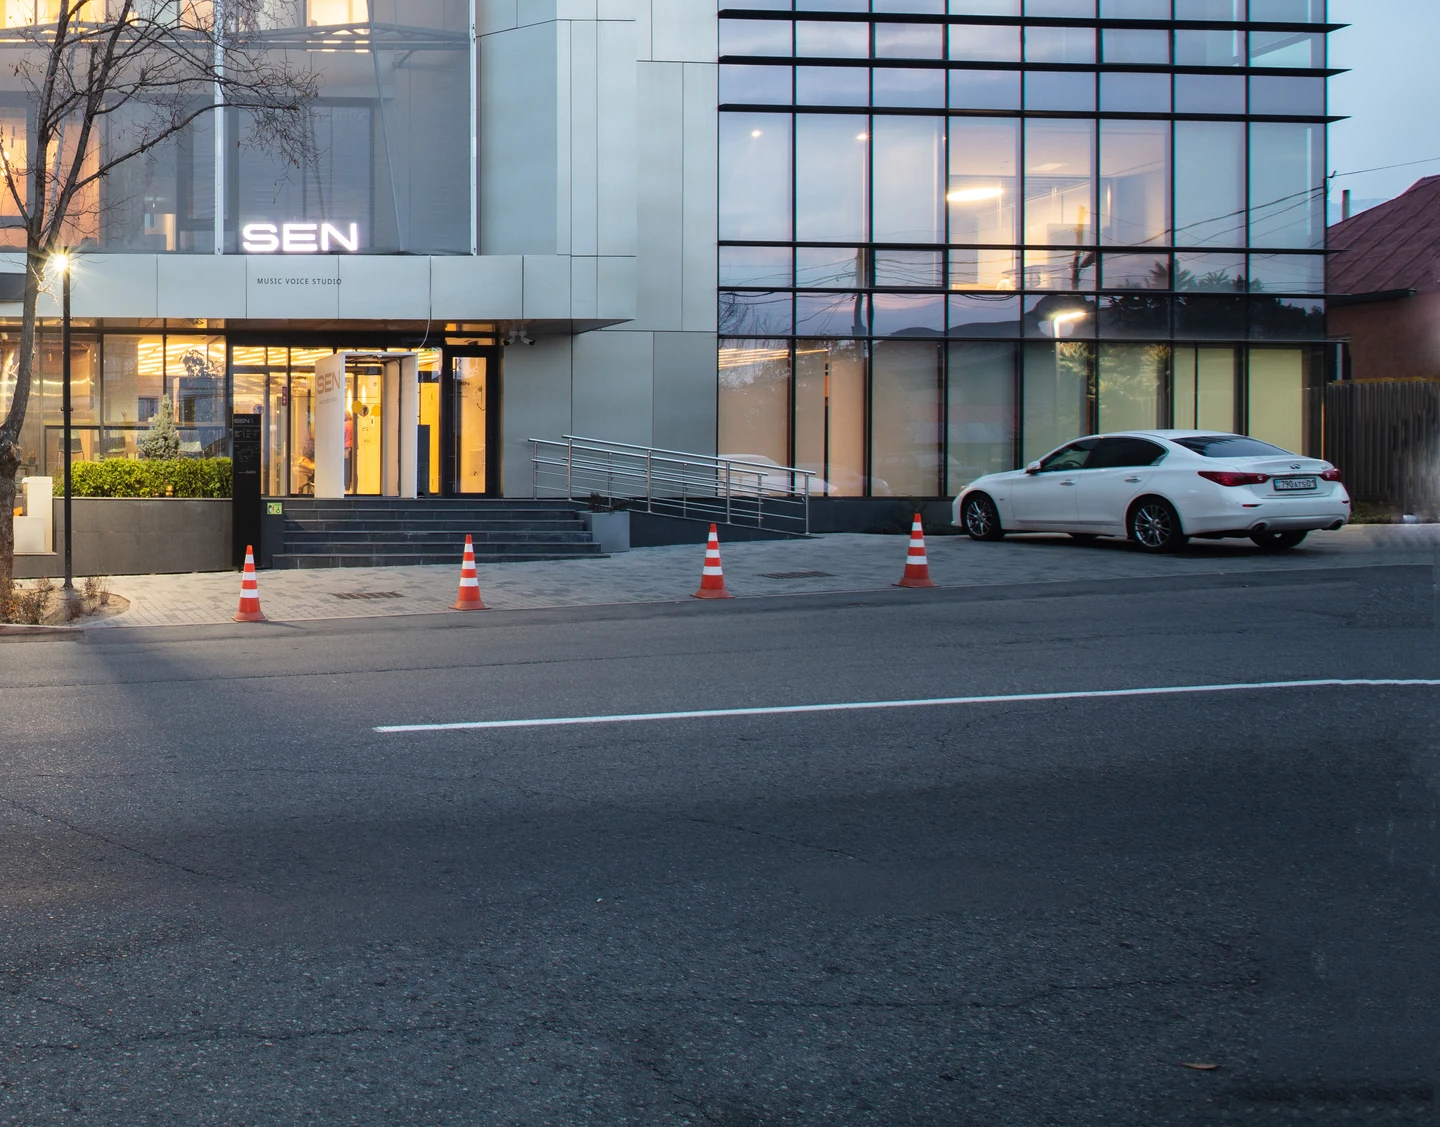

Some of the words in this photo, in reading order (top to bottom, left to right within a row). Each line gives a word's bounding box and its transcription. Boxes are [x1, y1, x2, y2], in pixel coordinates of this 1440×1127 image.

[242, 222, 359, 252] SEN
[256, 277, 283, 285] MUSIC
[285, 277, 309, 285] VOICE
[316, 370, 341, 395] SEN
